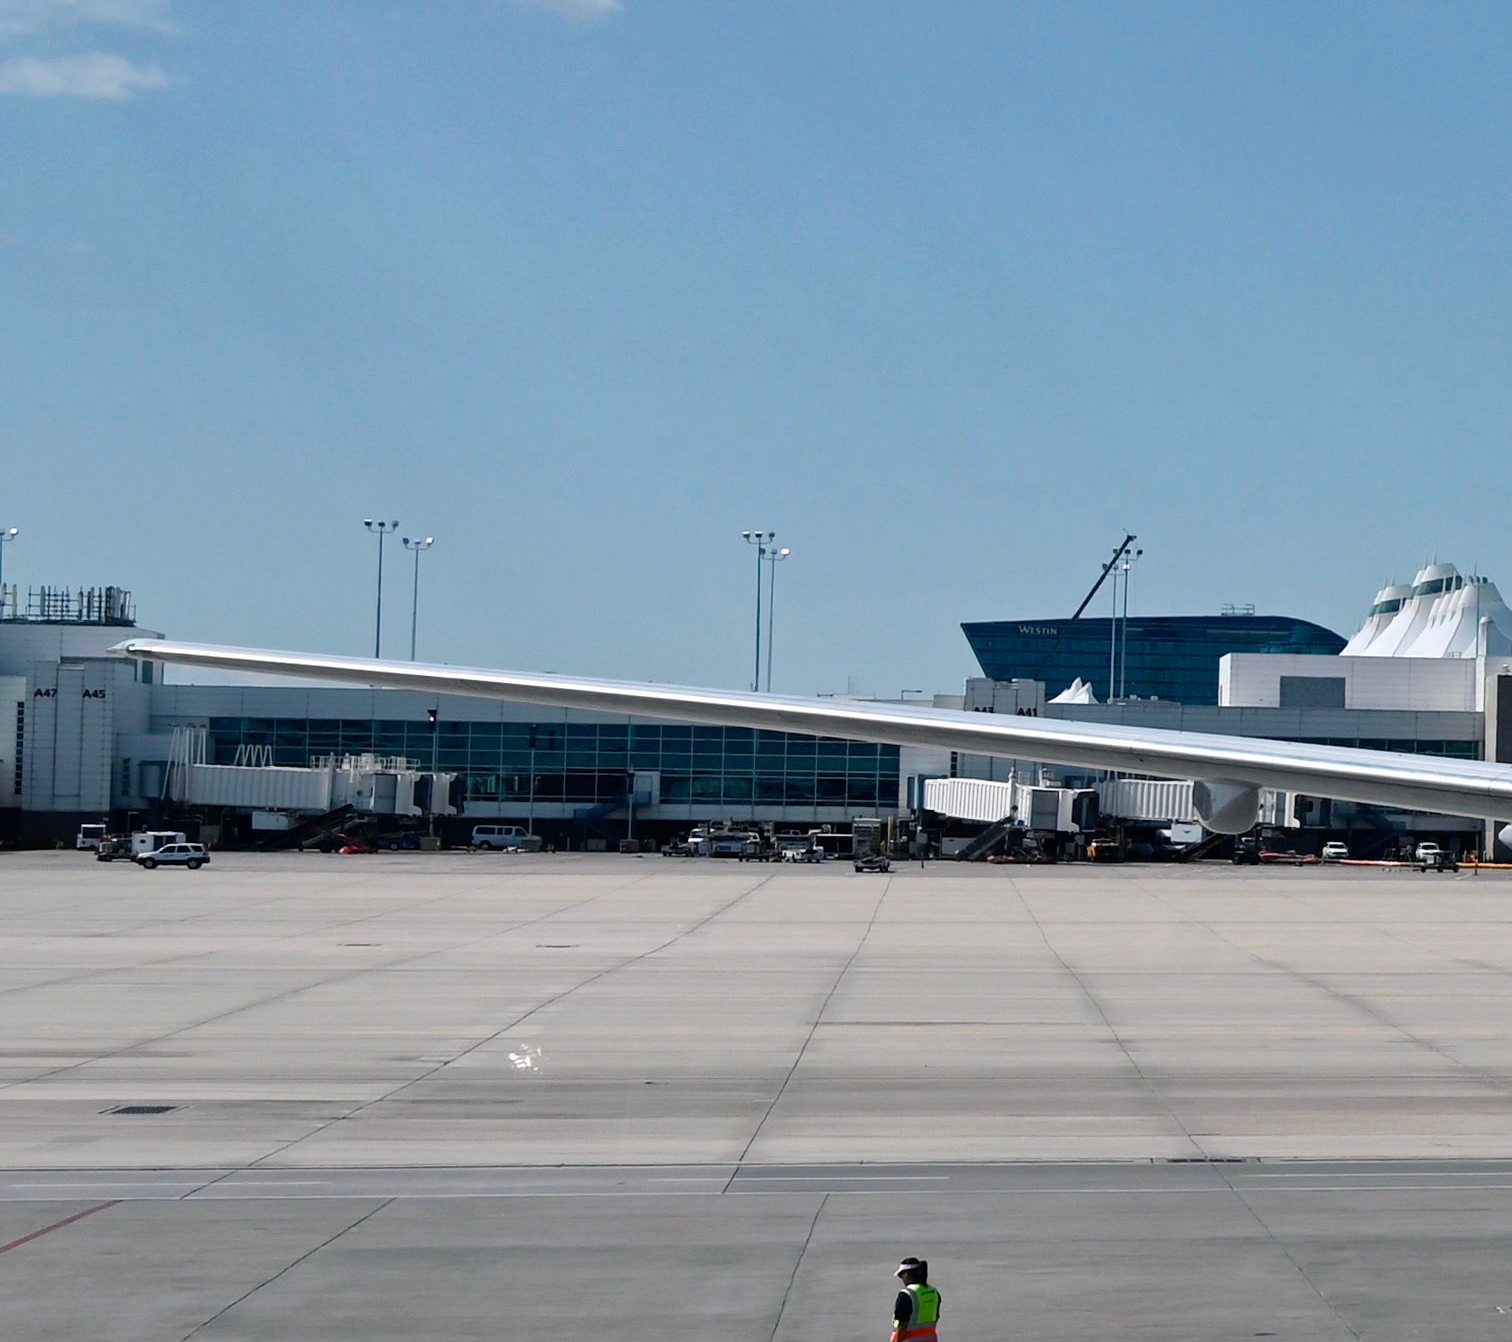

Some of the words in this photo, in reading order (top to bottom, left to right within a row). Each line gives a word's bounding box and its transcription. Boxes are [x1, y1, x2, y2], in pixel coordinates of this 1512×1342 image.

[34, 688, 57, 698] A47
[83, 689, 106, 699] A45
[1017, 707, 1038, 717] A41
